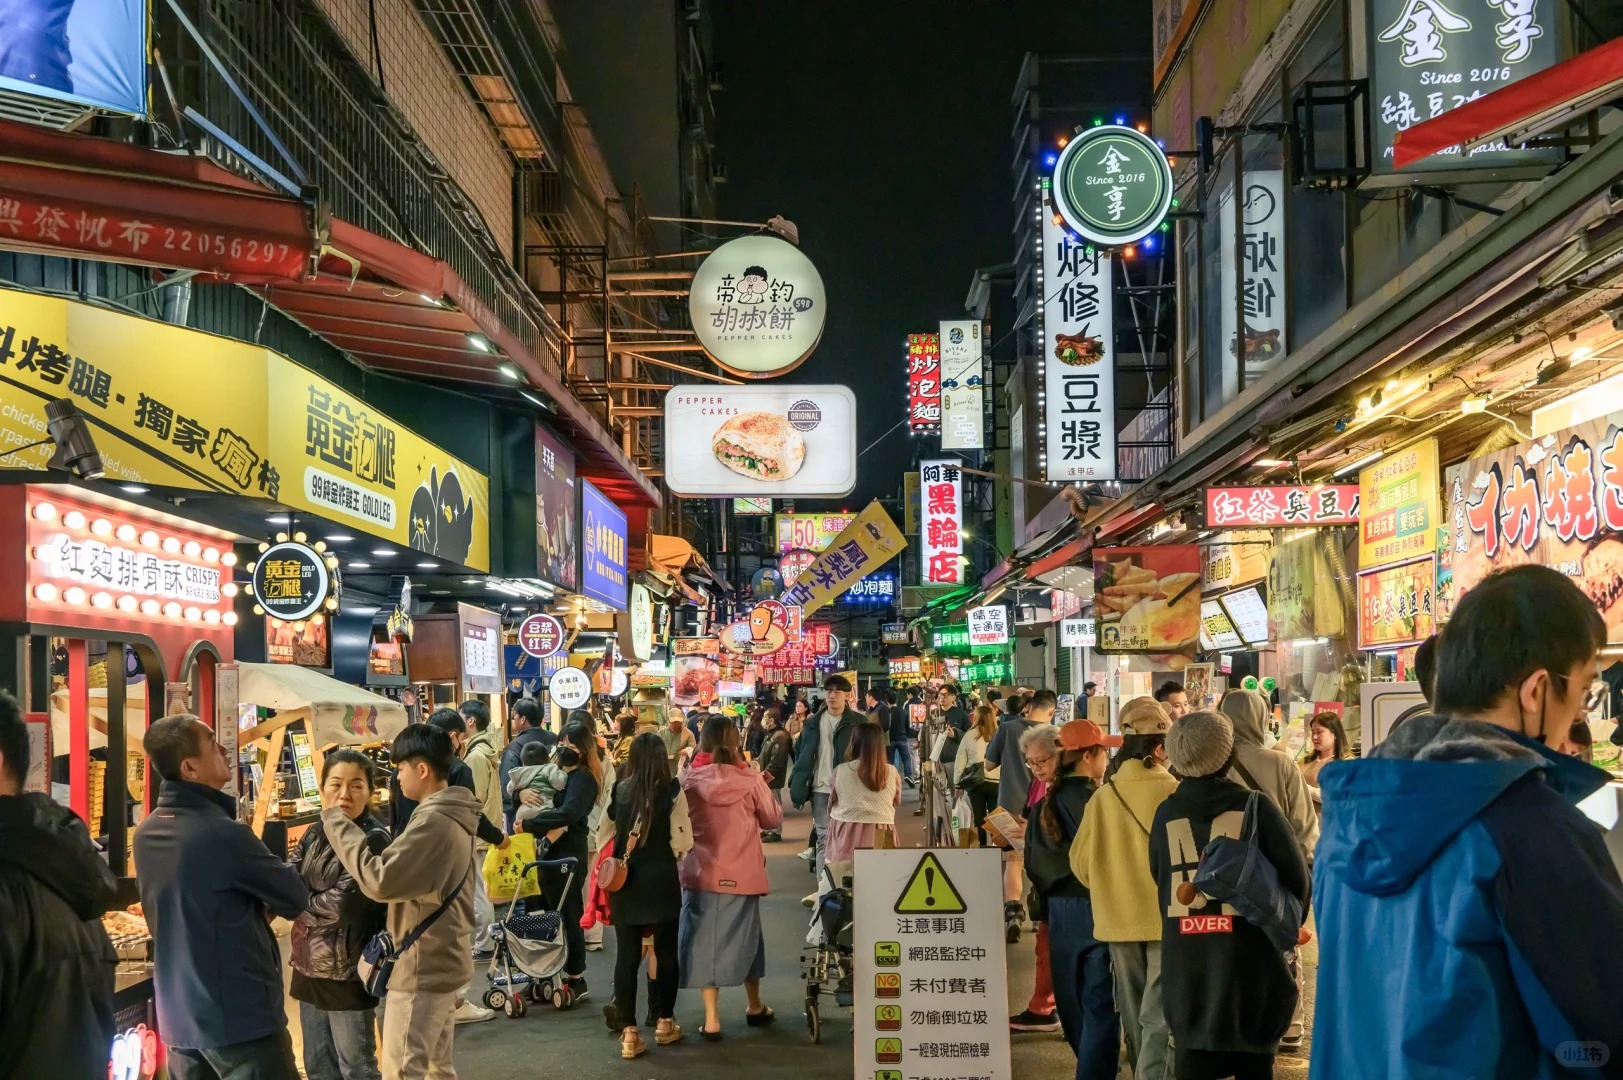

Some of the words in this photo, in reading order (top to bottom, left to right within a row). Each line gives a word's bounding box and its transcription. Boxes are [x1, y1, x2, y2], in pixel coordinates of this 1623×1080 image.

[1420, 71, 1462, 85] Since
[1470, 66, 1511, 82] 2016
[1098, 144, 1130, 174] 金
[1085, 176, 1114, 185] Since
[1118, 173, 1145, 183] 2016
[1103, 185, 1127, 221] 享
[164, 227, 289, 263] 22056297
[710, 304, 796, 333] 胡椒餅
[911, 355, 940, 421] 炒泡麵
[678, 397, 723, 405] PEPPER
[701, 407, 739, 415] CAKES
[790, 412, 820, 420] ORIGINAL
[1061, 373, 1102, 461] 豆漿
[1067, 466, 1095, 477] 逢甲店
[362, 493, 379, 518] GOLD
[379, 499, 391, 523] LEG
[927, 482, 959, 583] 黑輪店
[186, 566, 220, 587] CRISPY
[265, 560, 302, 578] 黃金
[185, 586, 204, 599] SPARE
[205, 589, 219, 601] RIBS
[972, 609, 1002, 620] 晴空
[972, 621, 1004, 633] 卡通屋
[896, 917, 966, 934] 注意事項
[908, 946, 986, 961] 網路監控中
[909, 978, 987, 994] 未付費者
[909, 1010, 988, 1025] 勿偷倒垃圾
[908, 1042, 990, 1058] 一經發現拍照檢舉
